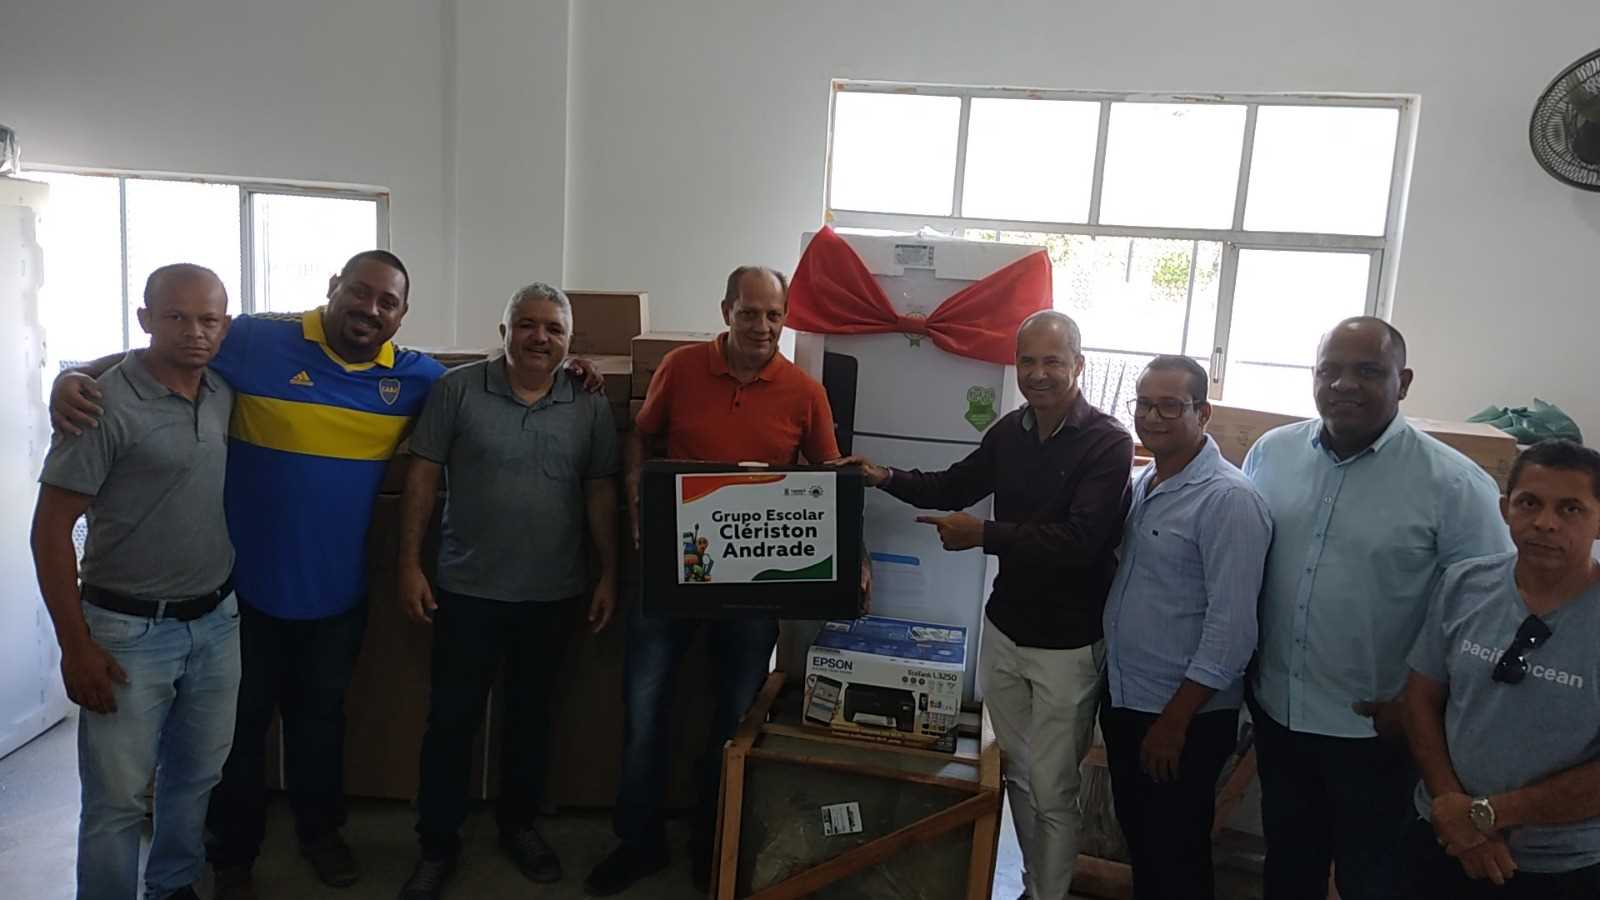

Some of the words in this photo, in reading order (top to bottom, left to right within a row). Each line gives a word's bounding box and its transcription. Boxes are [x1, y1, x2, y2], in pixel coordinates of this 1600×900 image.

[712, 510, 762, 524] Grupo
[766, 509, 825, 522] Escolar
[719, 522, 818, 540] Clériston
[722, 541, 816, 558] Andrade
[1460, 639, 1505, 664] pacif
[812, 655, 853, 671] EPSON
[933, 672, 958, 682] L3250
